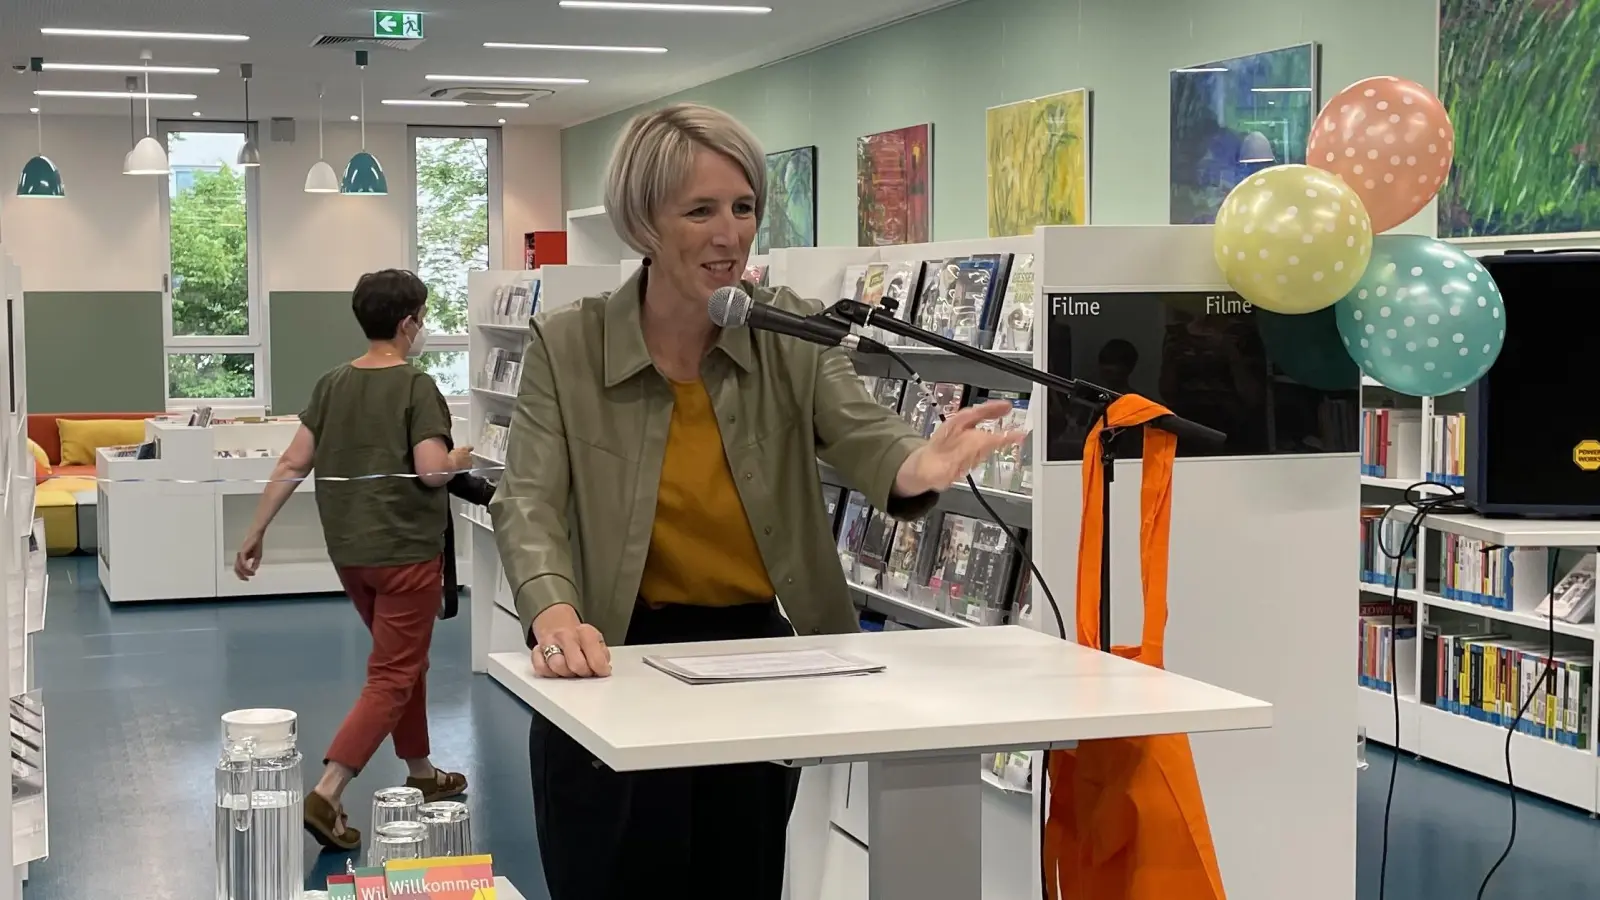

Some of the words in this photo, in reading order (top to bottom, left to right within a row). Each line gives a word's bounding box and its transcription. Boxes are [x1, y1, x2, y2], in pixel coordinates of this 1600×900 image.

[1052, 296, 1100, 316] Filme
[1206, 296, 1252, 315] Filme
[389, 876, 490, 896] Willkommen
